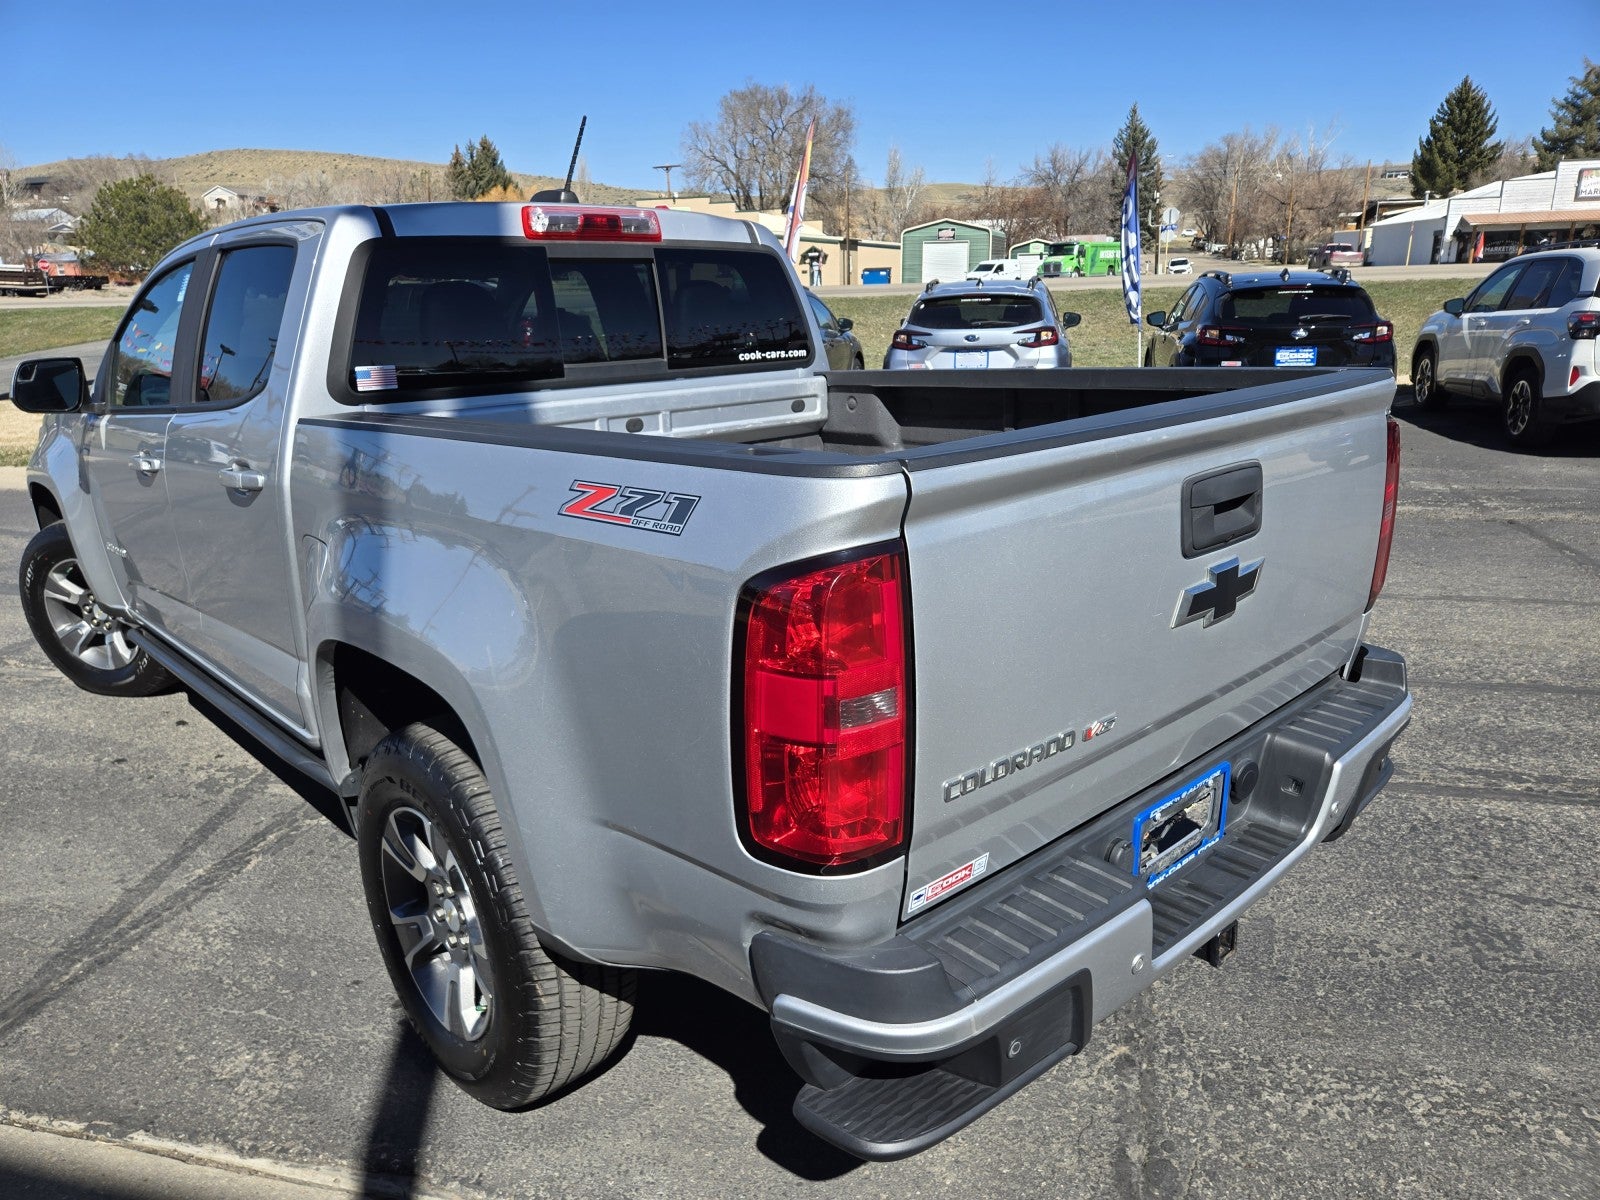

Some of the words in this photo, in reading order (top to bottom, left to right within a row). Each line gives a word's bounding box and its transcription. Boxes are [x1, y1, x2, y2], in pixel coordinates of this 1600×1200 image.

[739, 349, 807, 361] cook-cars.com
[558, 479, 702, 528] Z71
[631, 518, 651, 528] OFF
[651, 521, 682, 533] ROAD
[942, 728, 1077, 803] COLORADO
[927, 866, 973, 898] COOK
